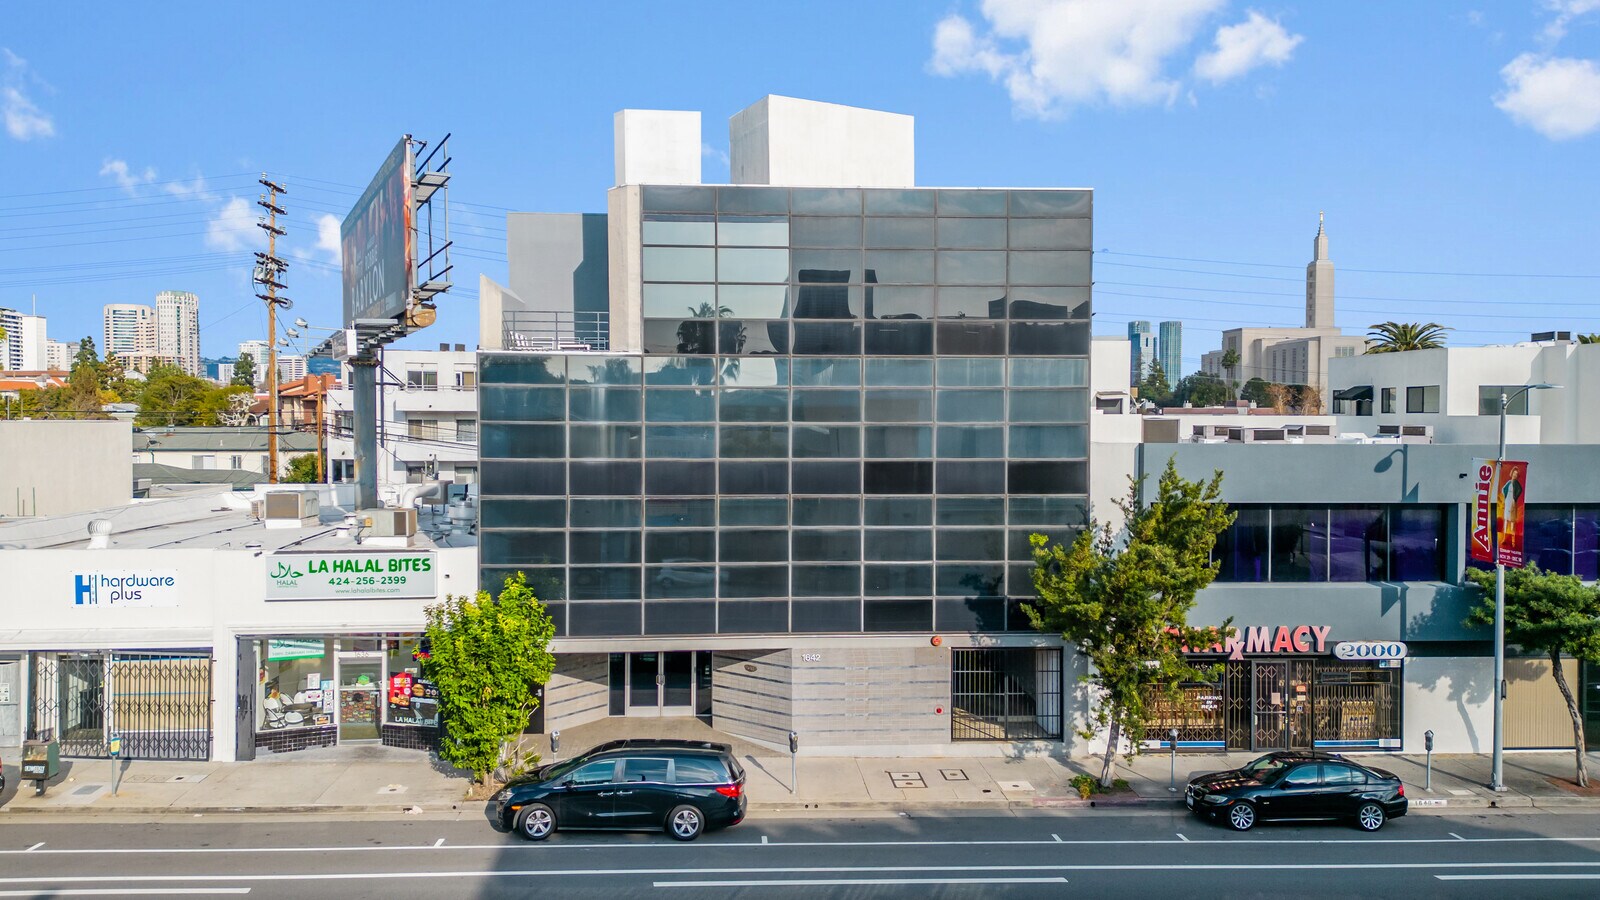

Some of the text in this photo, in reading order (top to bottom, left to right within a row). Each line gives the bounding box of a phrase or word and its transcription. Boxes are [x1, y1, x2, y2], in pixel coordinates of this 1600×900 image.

[352, 259, 385, 317] BABYLON
[1473, 464, 1493, 552] Annie
[308, 557, 432, 574] LA HALAL BITES
[101, 574, 175, 587] hardware
[328, 576, 407, 585] 424-256-2399
[110, 588, 142, 604] plus
[801, 653, 821, 662] 1642
[1341, 644, 1402, 657] 2000
